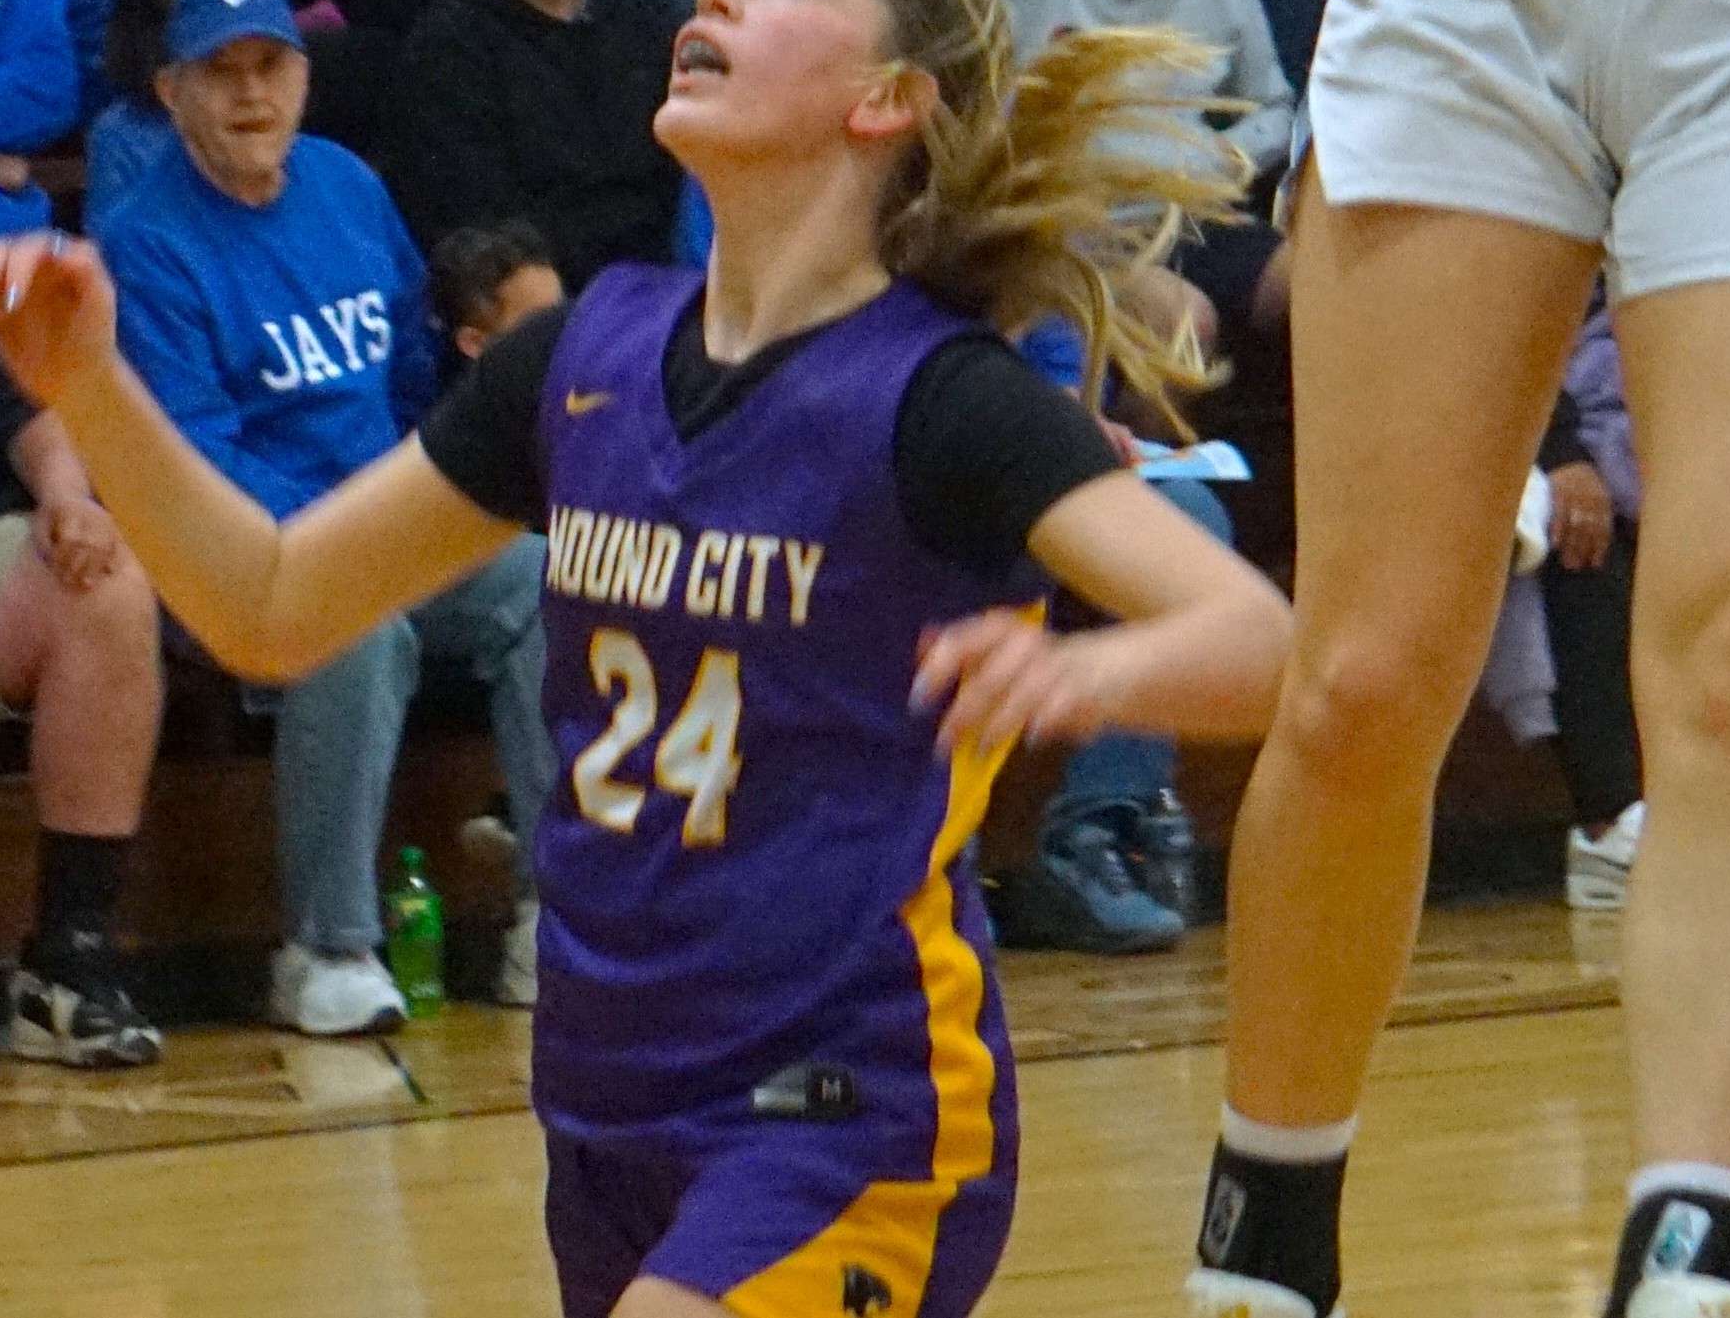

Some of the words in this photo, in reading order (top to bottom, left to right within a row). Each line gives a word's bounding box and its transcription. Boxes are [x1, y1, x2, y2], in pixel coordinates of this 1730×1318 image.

[259, 289, 392, 391] JAYS
[684, 528, 825, 629] CITY
[572, 626, 742, 850] 24
